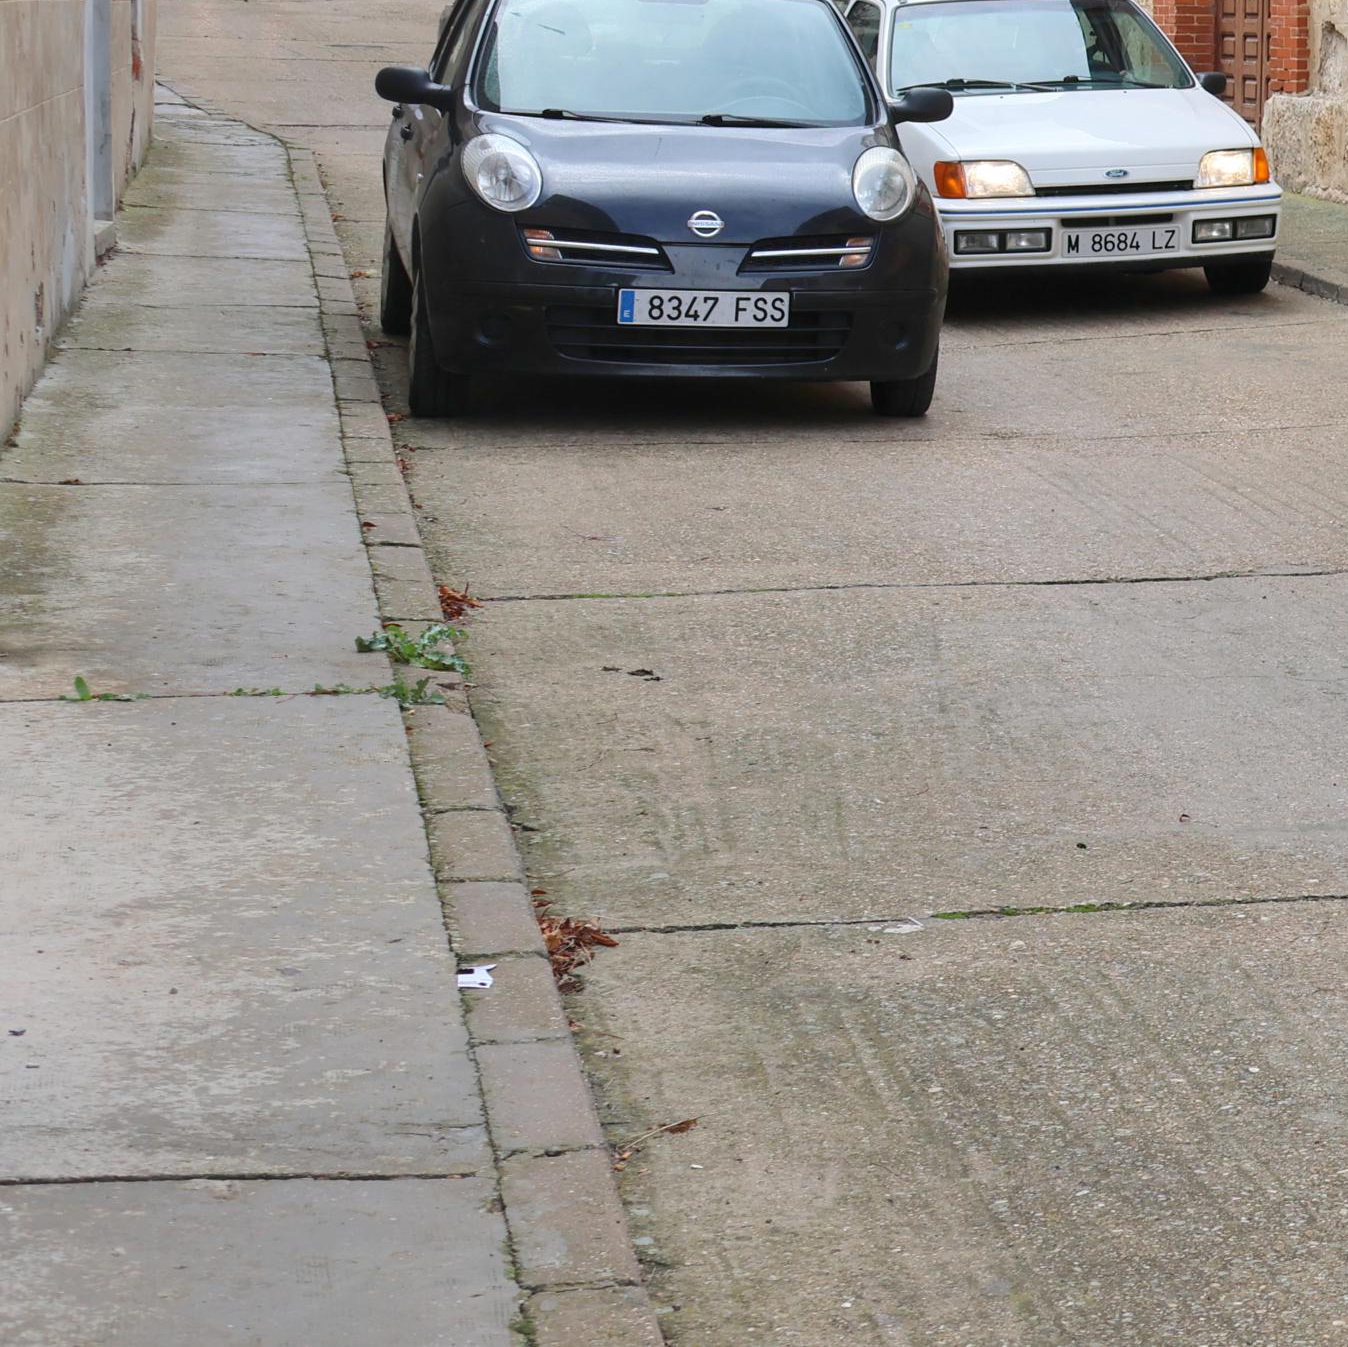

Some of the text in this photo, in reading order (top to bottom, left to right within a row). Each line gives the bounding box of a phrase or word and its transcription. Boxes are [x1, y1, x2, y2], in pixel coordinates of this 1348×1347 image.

[1067, 229, 1176, 254] M 8684 LZ
[648, 295, 719, 322] 8347
[734, 297, 785, 322] FSS
